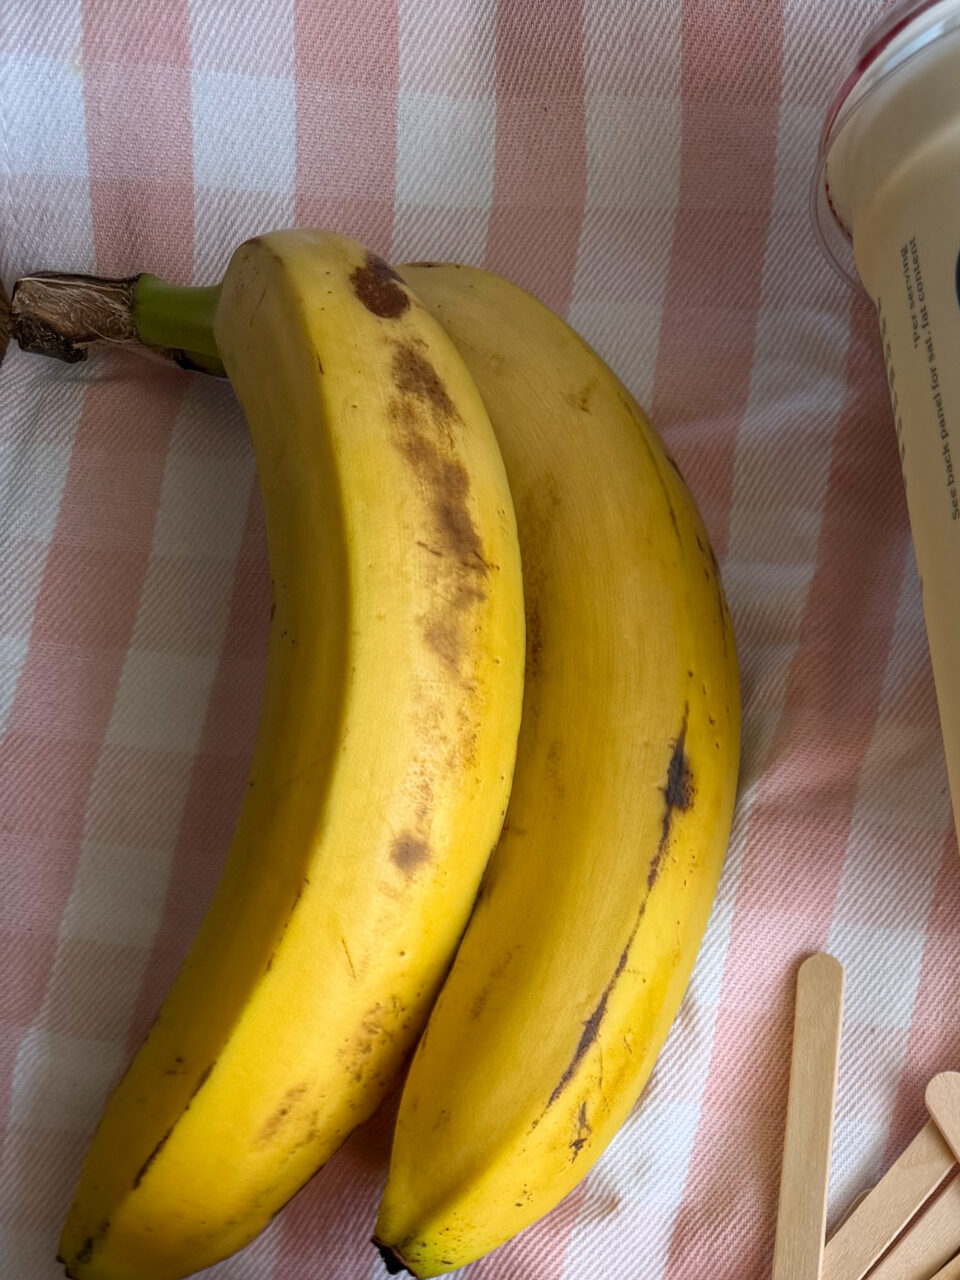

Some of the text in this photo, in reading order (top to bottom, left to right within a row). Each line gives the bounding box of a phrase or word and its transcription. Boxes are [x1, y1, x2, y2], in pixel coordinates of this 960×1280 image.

[909, 235, 925, 303] content
[919, 304, 930, 329] fat
[930, 366, 940, 391] for
[933, 392, 949, 440] panel
[942, 442, 955, 487] back
[950, 487, 960, 521] See
